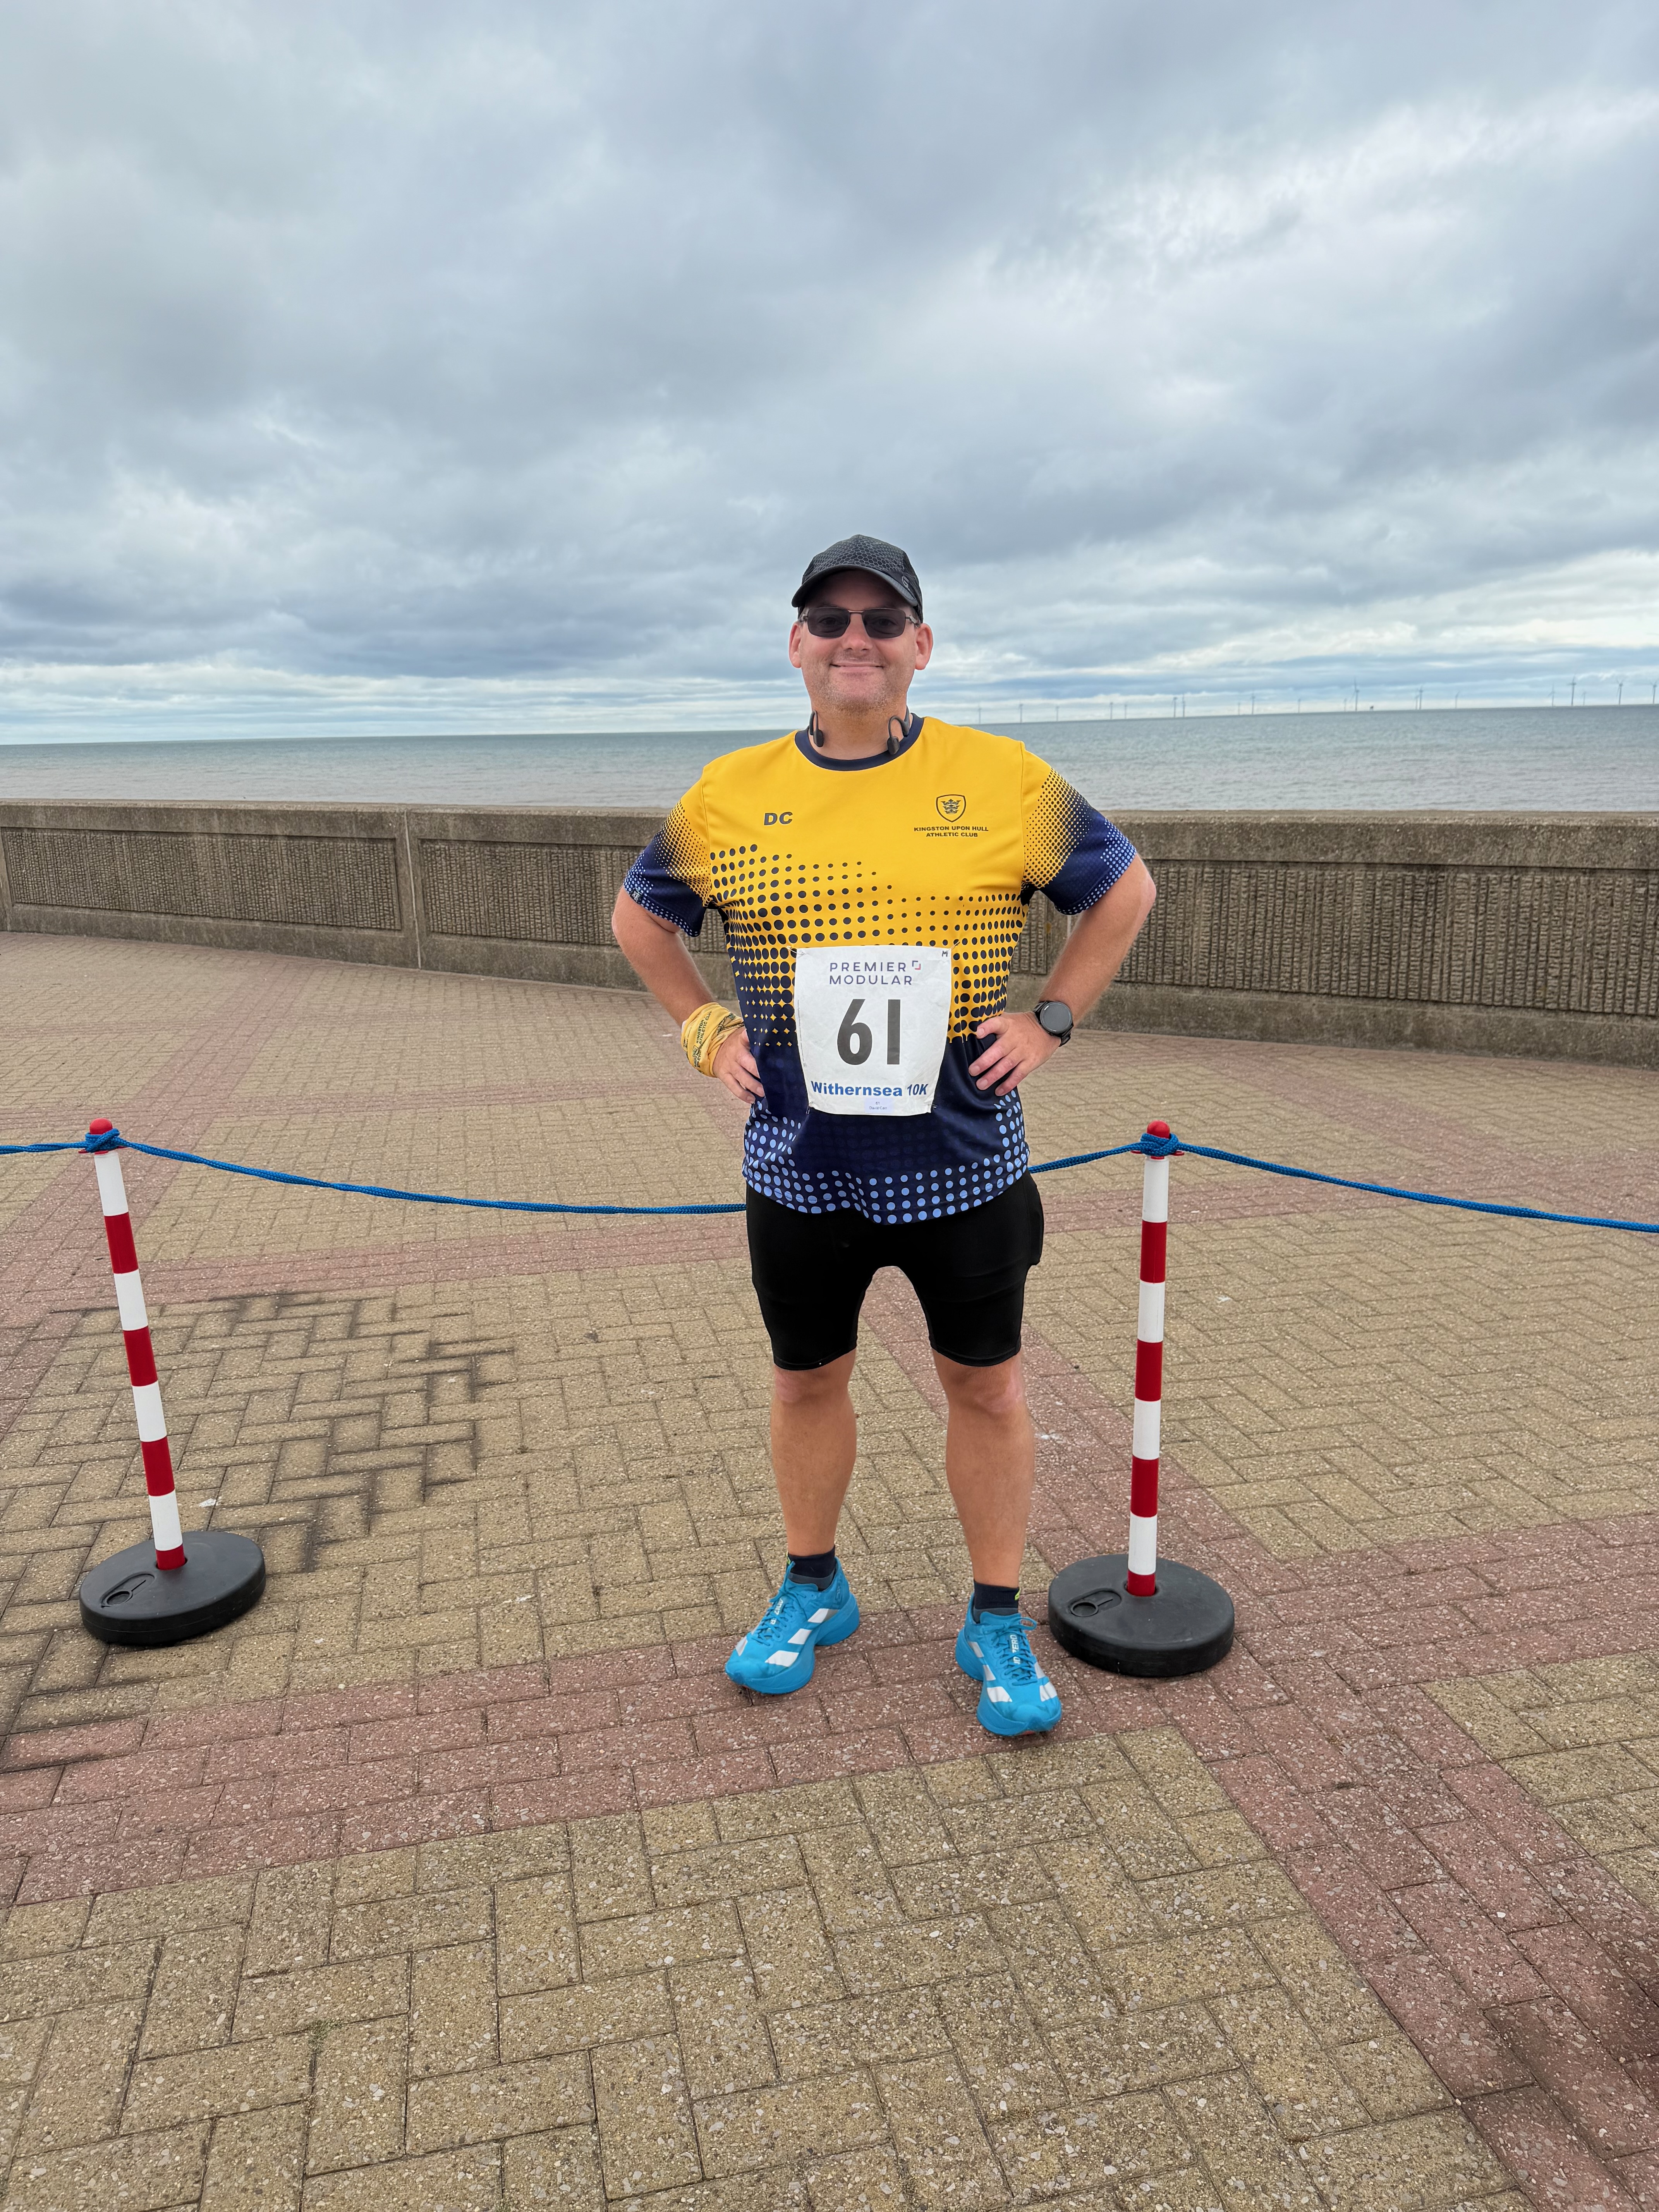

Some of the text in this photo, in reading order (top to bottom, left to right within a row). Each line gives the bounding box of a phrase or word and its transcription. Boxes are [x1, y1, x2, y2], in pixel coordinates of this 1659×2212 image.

[764, 812, 793, 825] DC
[830, 962, 906, 972] PREMIER
[830, 975, 912, 985] MODULAR
[699, 1021, 707, 1044] ATHLETIC
[837, 999, 901, 1065] 61
[811, 1080, 928, 1096] Withernsea 10K
